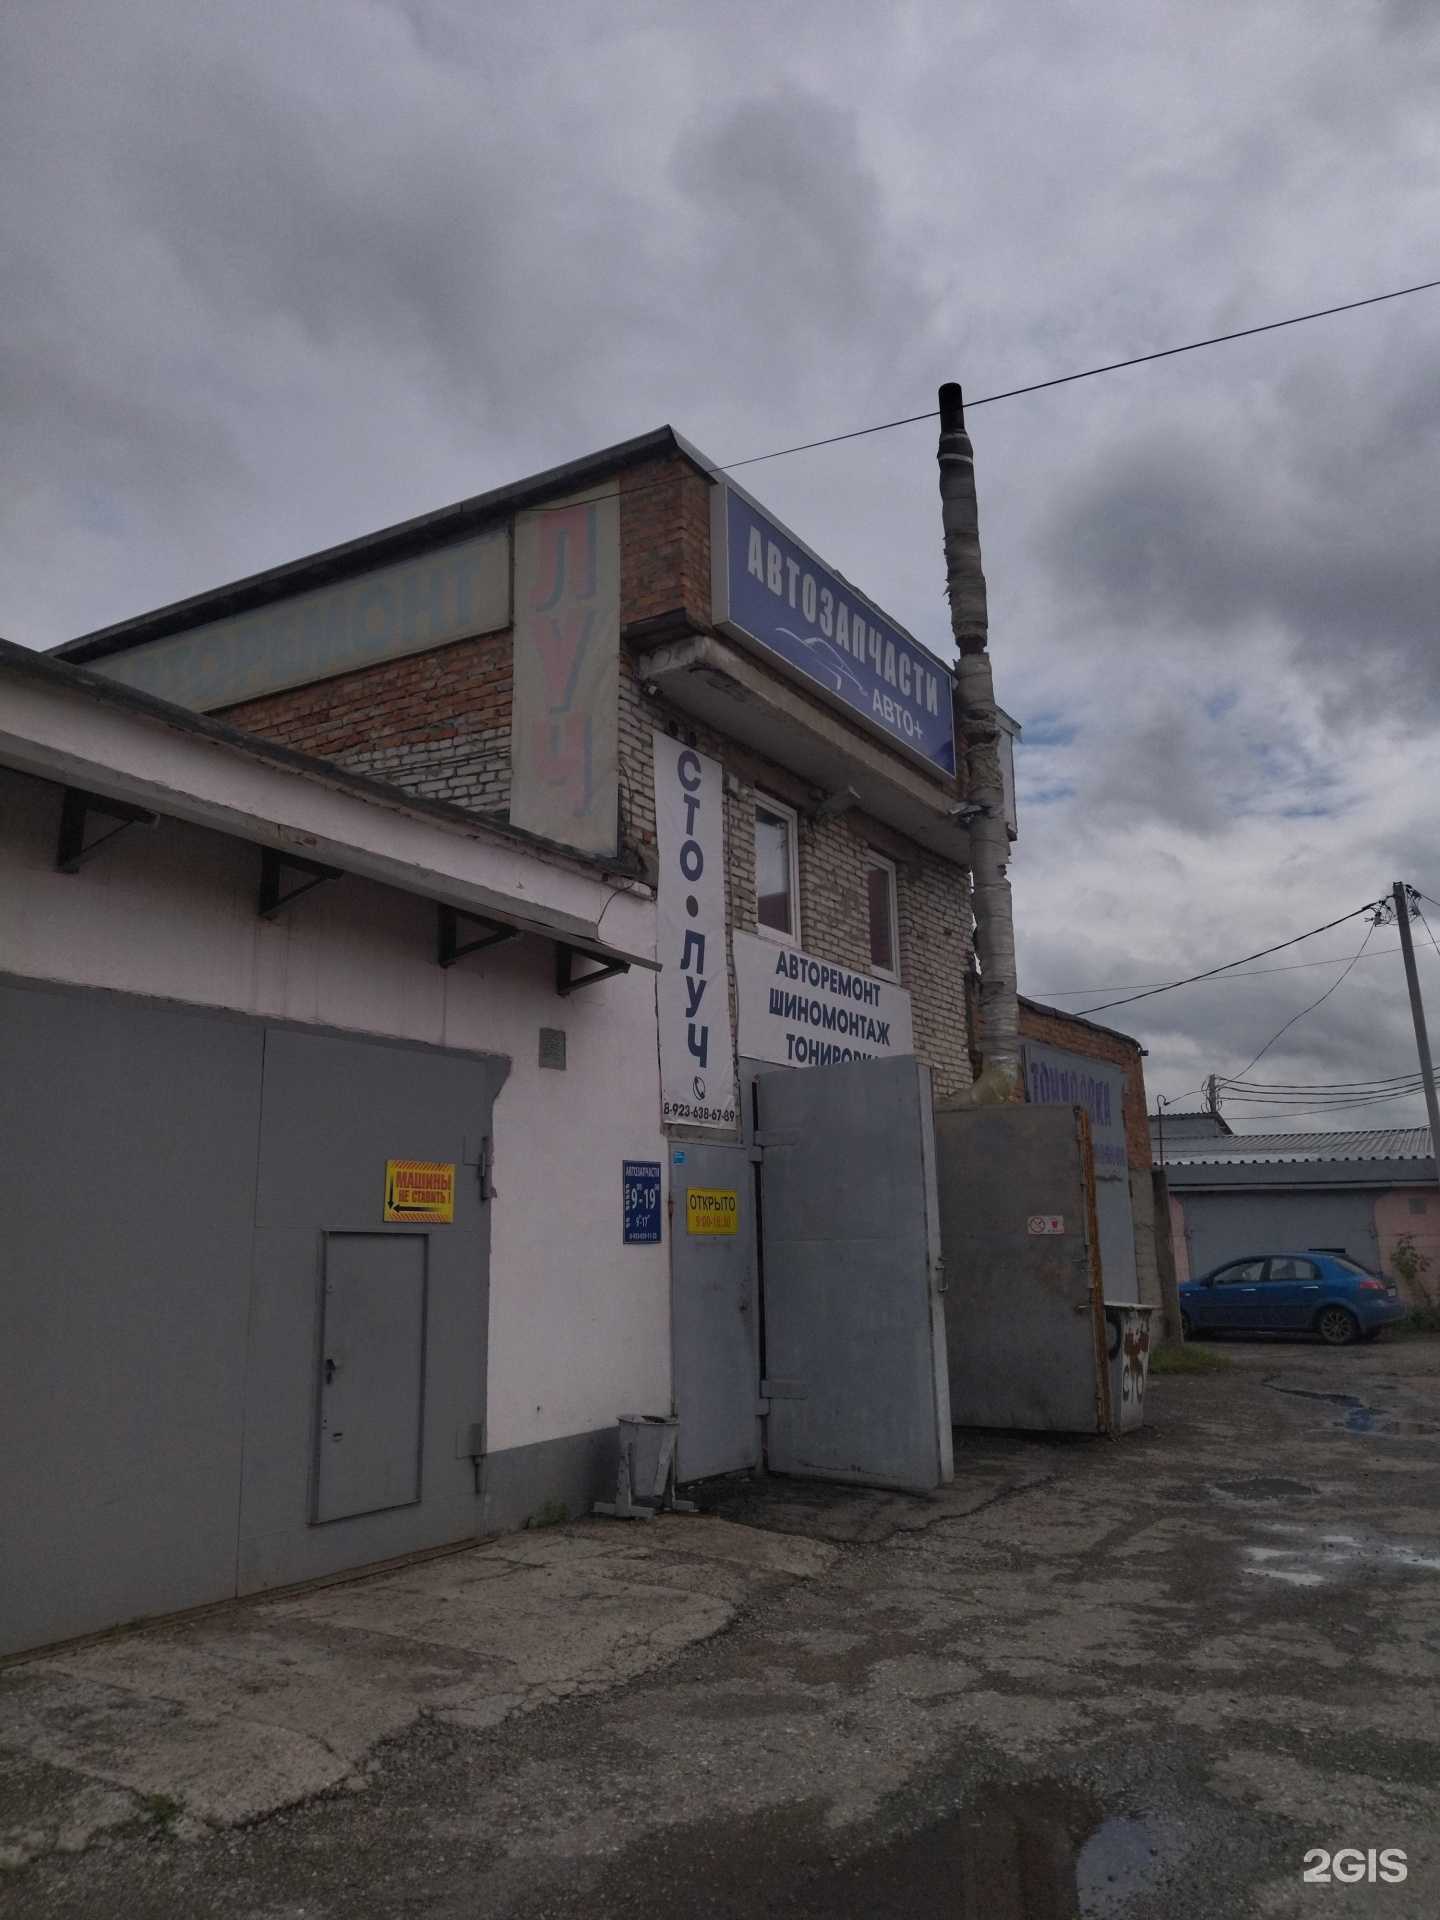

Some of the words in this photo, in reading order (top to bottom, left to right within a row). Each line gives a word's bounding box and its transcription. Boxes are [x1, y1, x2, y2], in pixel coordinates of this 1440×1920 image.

[748, 525, 938, 717] АВТОЗАПЧАСТИ
[530, 506, 598, 817] ЛУЧ
[872, 688, 923, 740] АВТО+
[677, 750, 704, 882] СТО
[680, 929, 709, 1069] ЛУЧ
[775, 950, 881, 1007] АВТОРЕМОНТ
[769, 987, 891, 1047] ШИНОМОНТАЖ
[664, 1102, 735, 1122] 8-923-638-67-89
[689, 1194, 736, 1212] ОТКРЫТО
